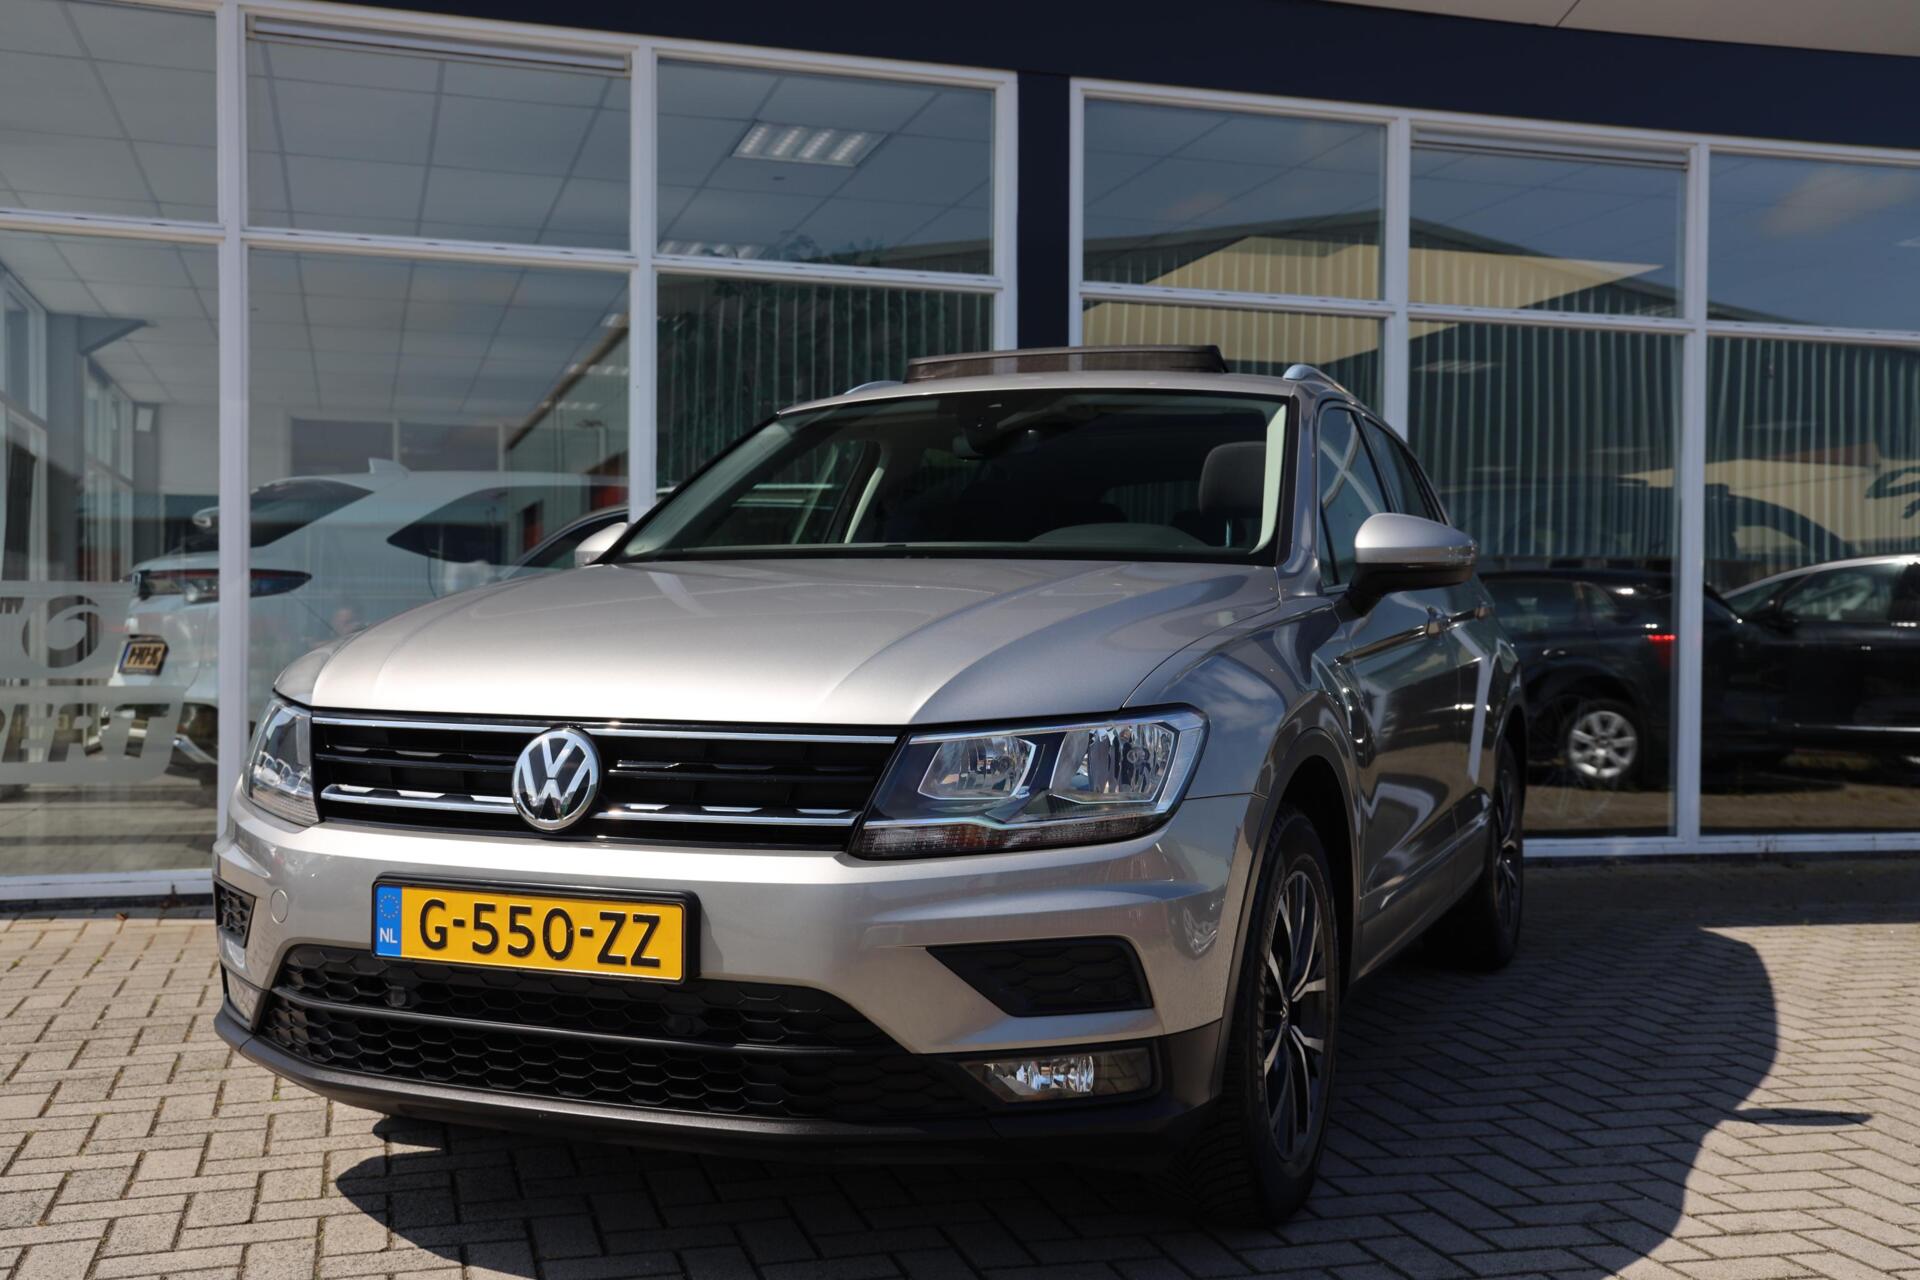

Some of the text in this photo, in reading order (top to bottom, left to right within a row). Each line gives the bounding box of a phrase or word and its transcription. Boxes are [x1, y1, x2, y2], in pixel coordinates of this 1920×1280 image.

[514, 731, 597, 828] VW
[379, 927, 398, 945] NL
[419, 898, 661, 968] G-550-ZZ
